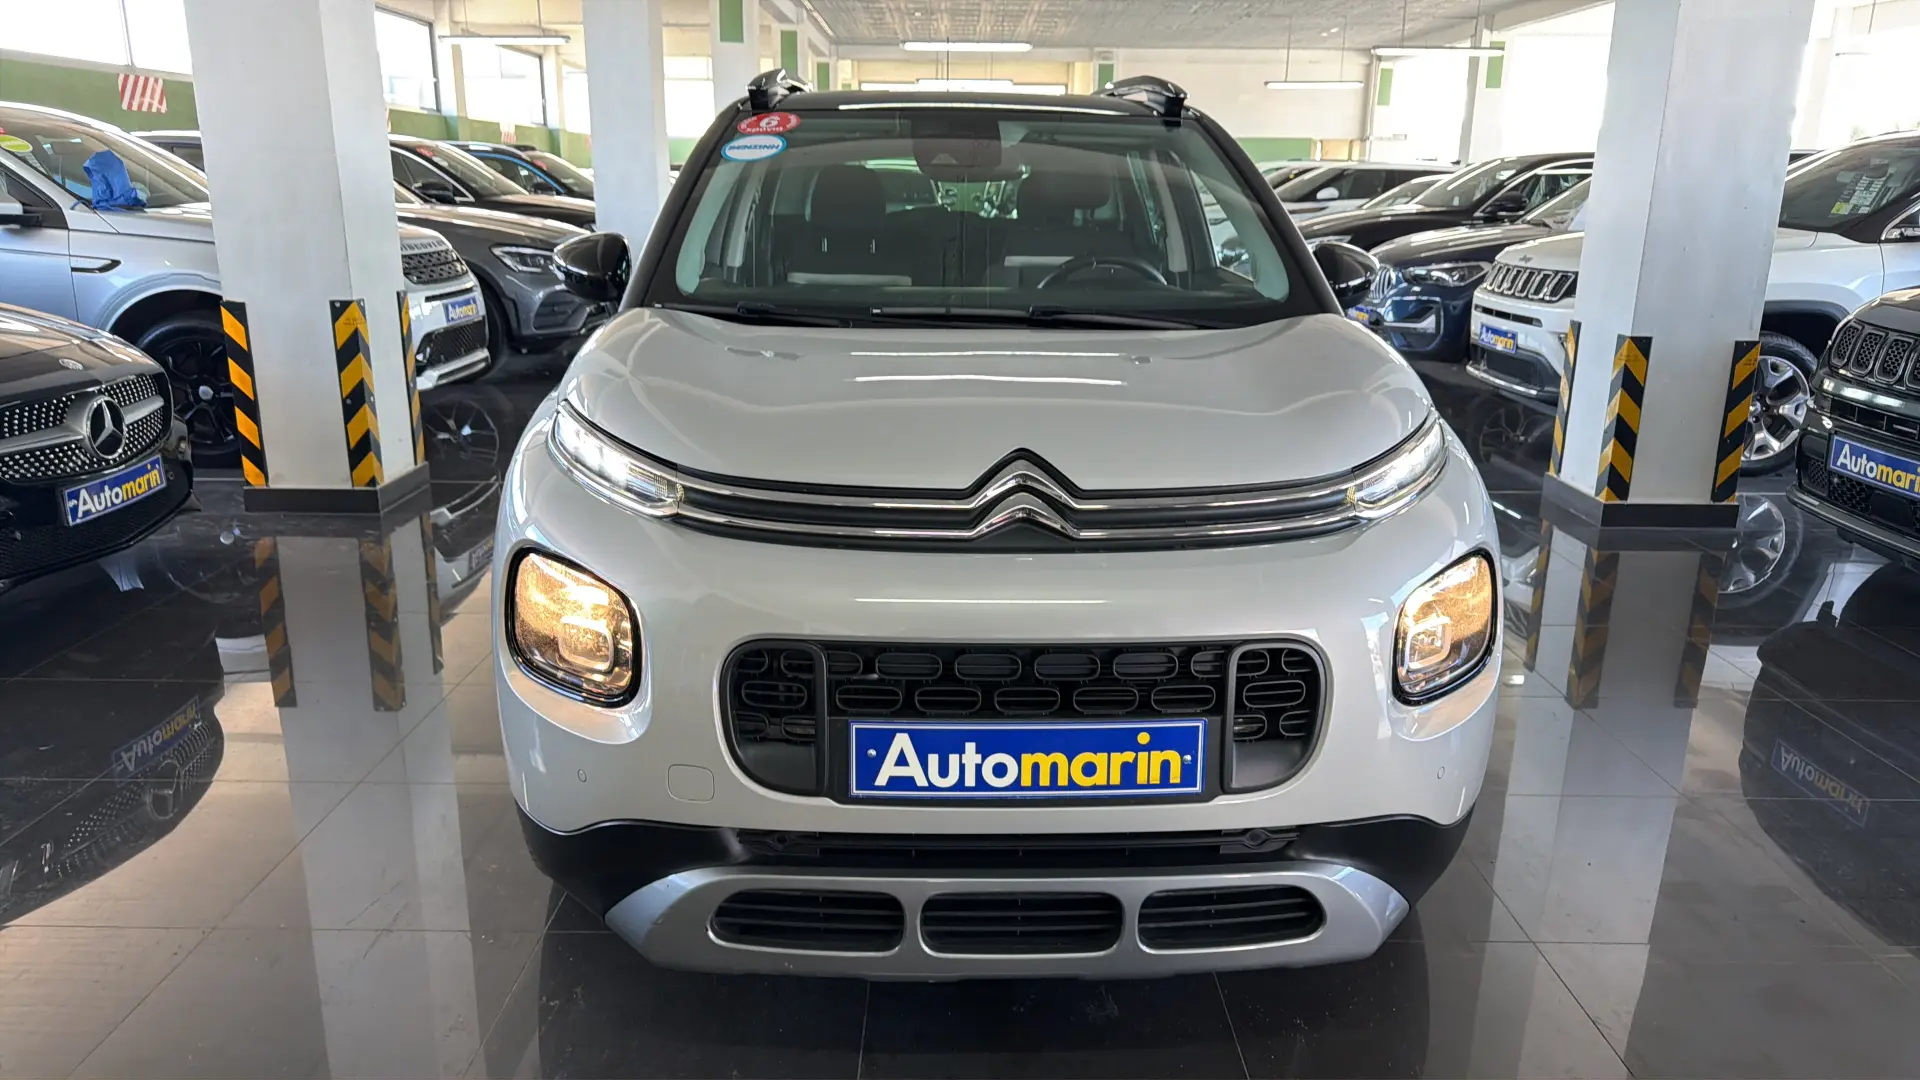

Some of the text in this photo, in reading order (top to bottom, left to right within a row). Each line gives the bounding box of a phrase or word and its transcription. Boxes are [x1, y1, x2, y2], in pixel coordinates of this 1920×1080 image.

[77, 463, 161, 518] Automarin
[1836, 443, 1920, 494] Automari
[874, 732, 1182, 788] Automarin
